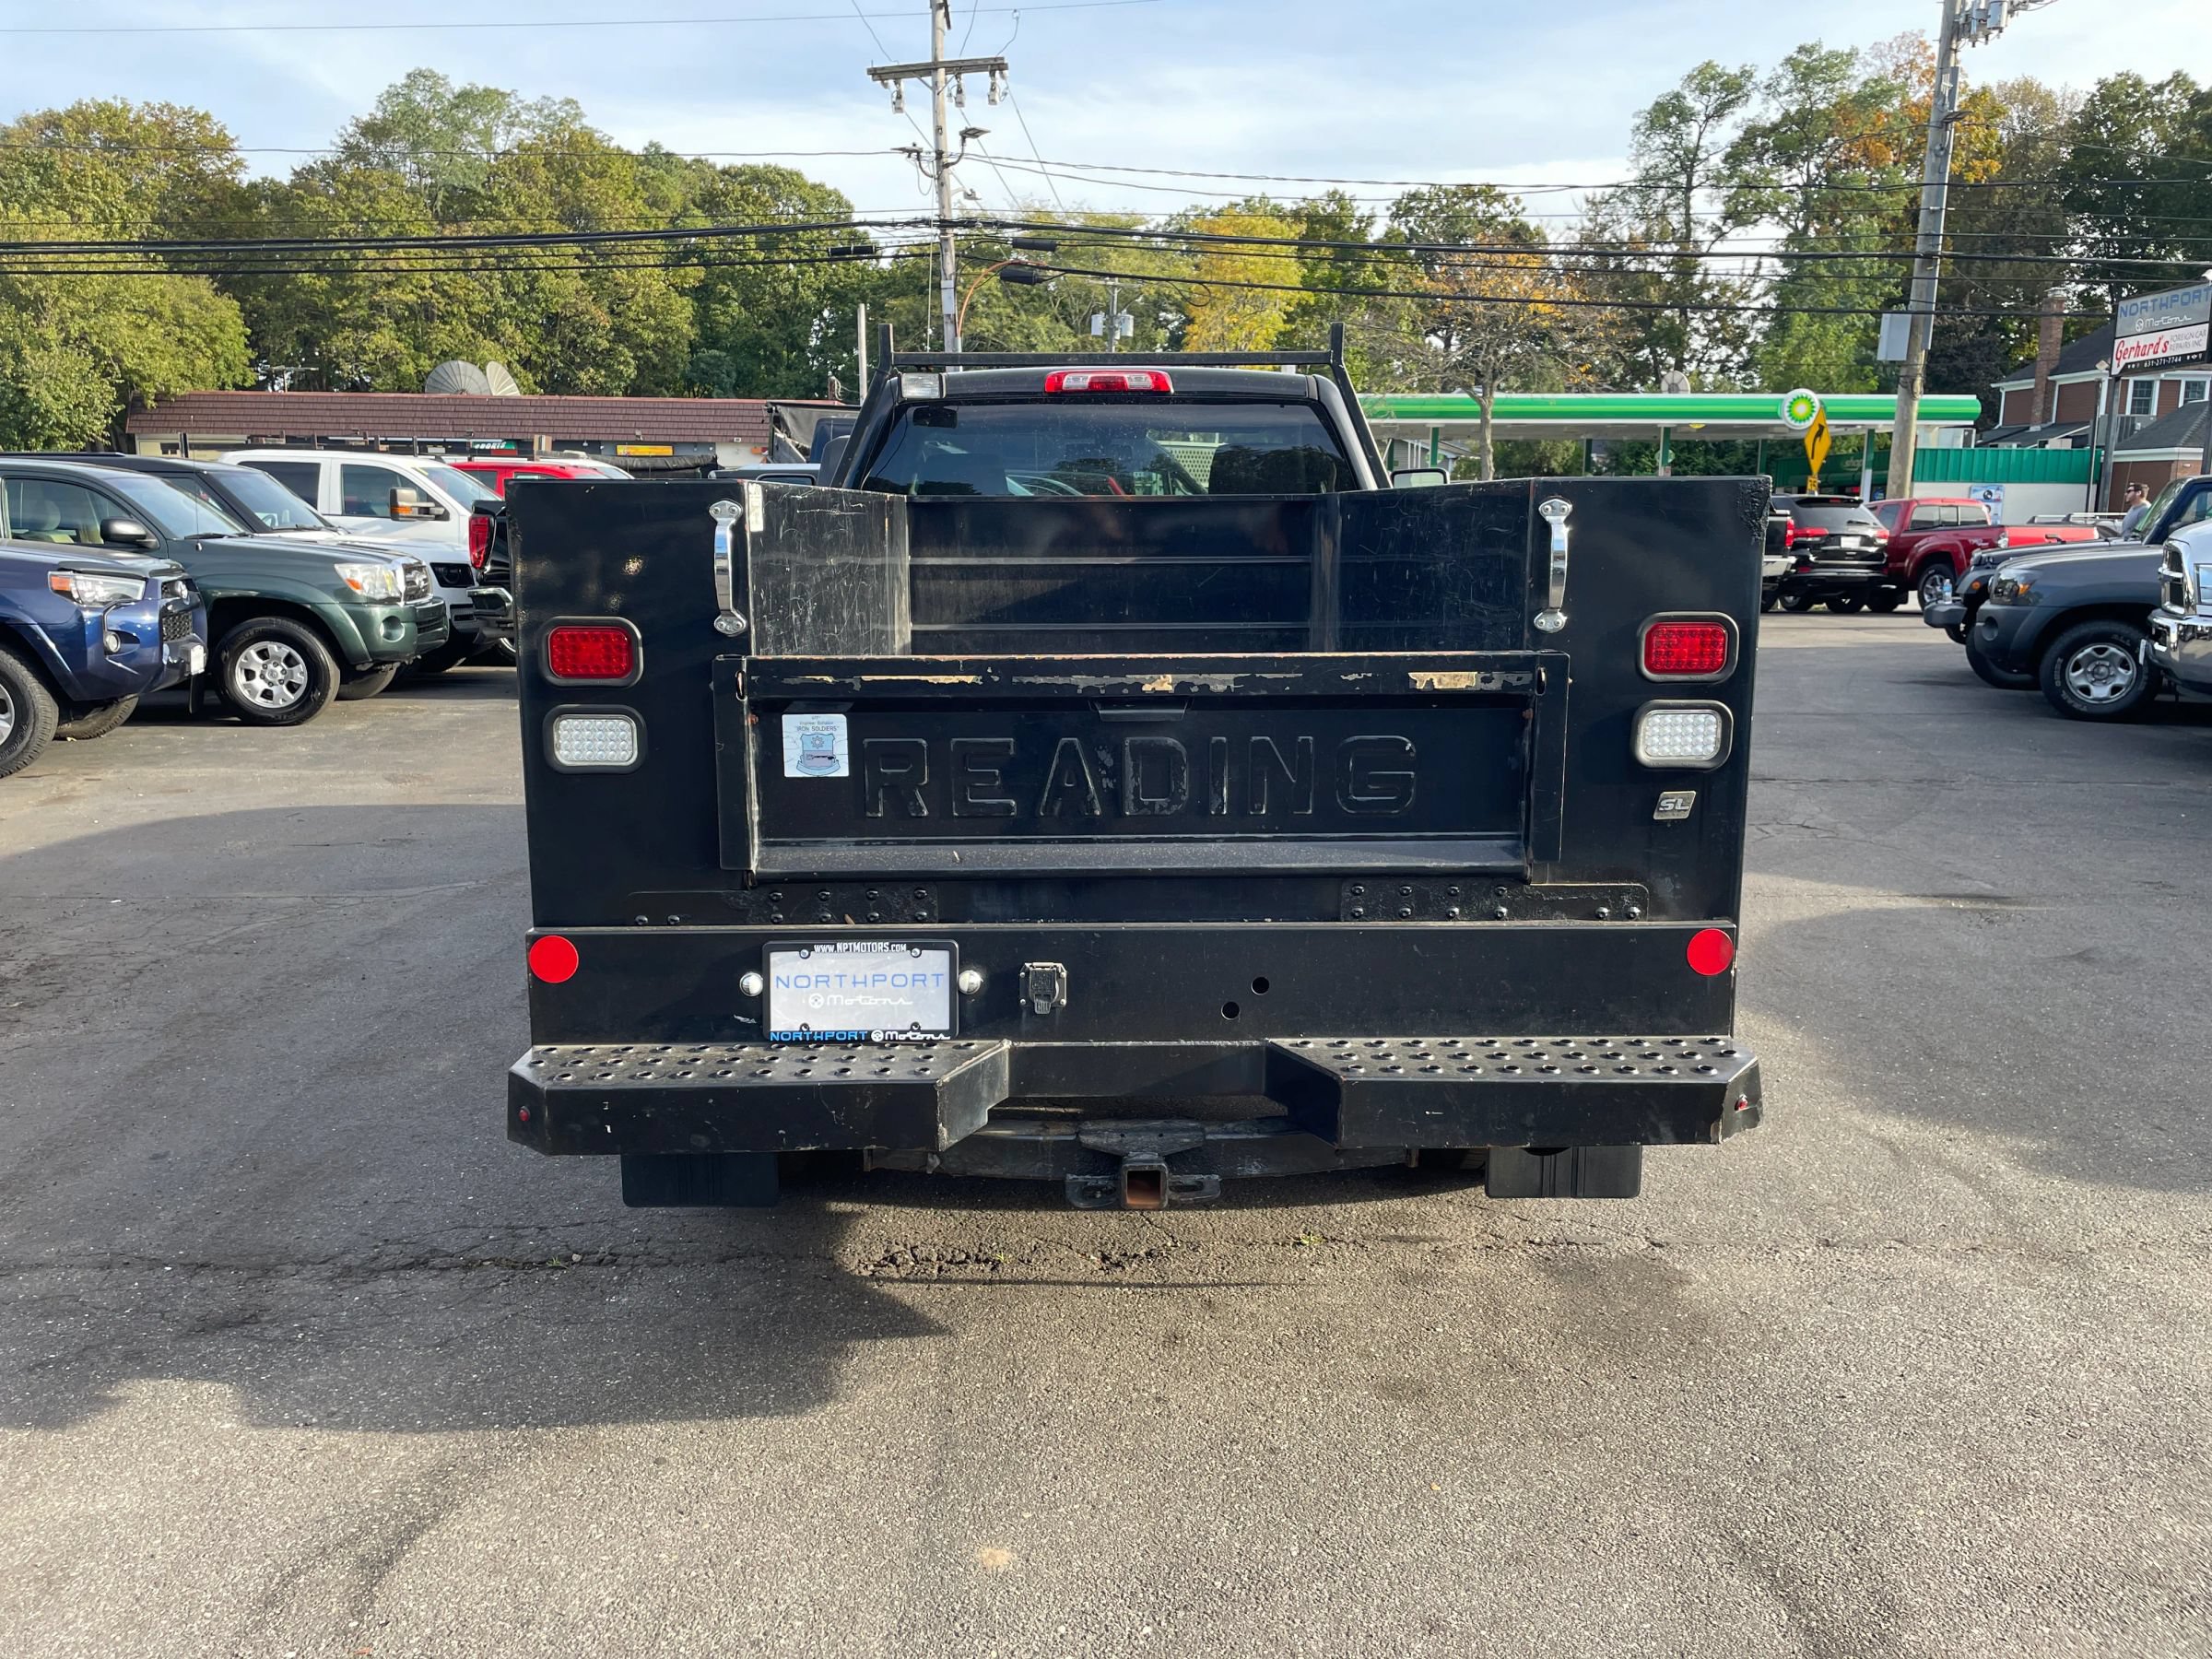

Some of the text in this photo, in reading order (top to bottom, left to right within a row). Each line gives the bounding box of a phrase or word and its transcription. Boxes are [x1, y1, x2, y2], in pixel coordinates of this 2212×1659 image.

[2120, 287, 2212, 318] NORTHPORT
[2145, 314, 2192, 328] Motors
[2115, 335, 2170, 368] Gerhard's
[863, 735, 1416, 818] READING
[1658, 798, 1690, 811] SL
[775, 973, 945, 989] NORTHPORT
[827, 994, 913, 1006] Motors
[770, 1030, 951, 1041] NORTHPORT Motors
